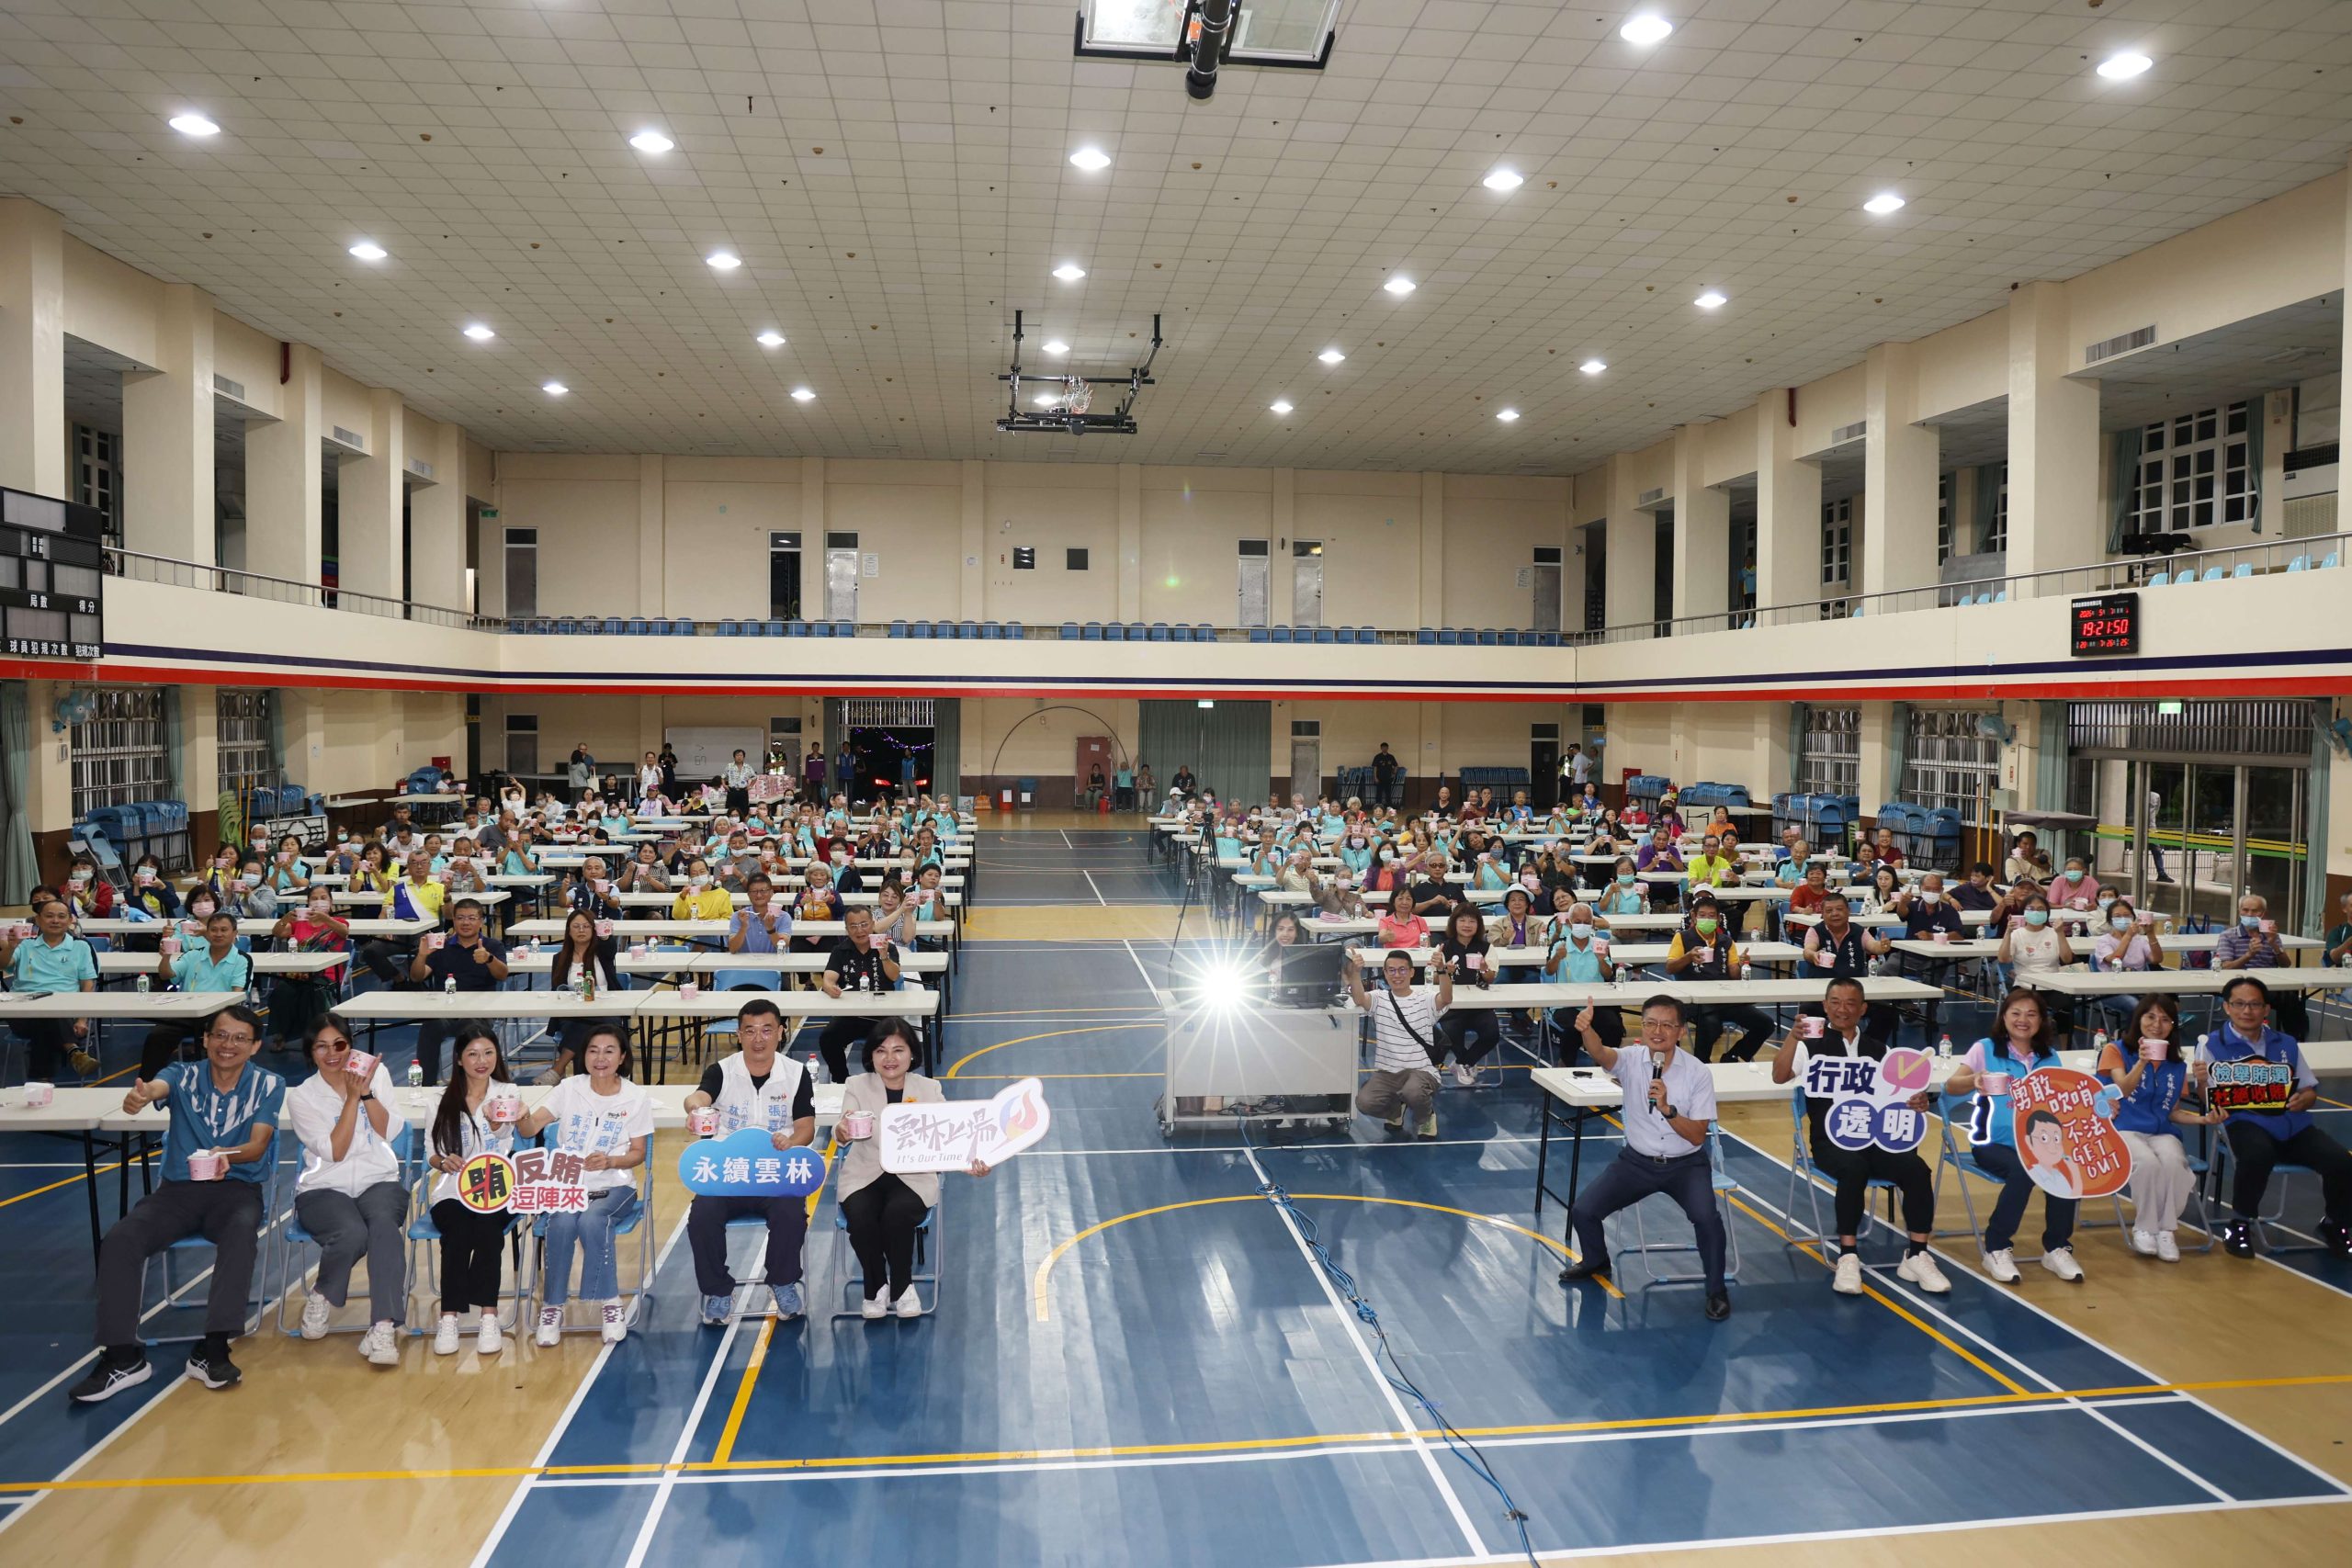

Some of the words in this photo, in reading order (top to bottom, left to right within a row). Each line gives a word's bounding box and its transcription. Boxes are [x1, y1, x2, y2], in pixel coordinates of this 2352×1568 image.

[79, 600, 95, 613] 得分
[9, 640, 68, 656] 球員犯規次數
[75, 644, 100, 658] 犯規次數
[1807, 1060, 1876, 1095] 行政
[2214, 1065, 2290, 1084] 檢舉賄選
[1836, 1106, 1917, 1142] 透明
[2063, 1114, 2106, 1144] 不法
[897, 1154, 915, 1164] It's
[918, 1153, 937, 1163] Our
[939, 1152, 963, 1162] Time
[2072, 1139, 2106, 1165] GET
[2086, 1151, 2120, 1179] OUT
[515, 1152, 585, 1185] 反賄
[692, 1156, 813, 1184] 永續雲林
[511, 1186, 585, 1211] 逗陣來
